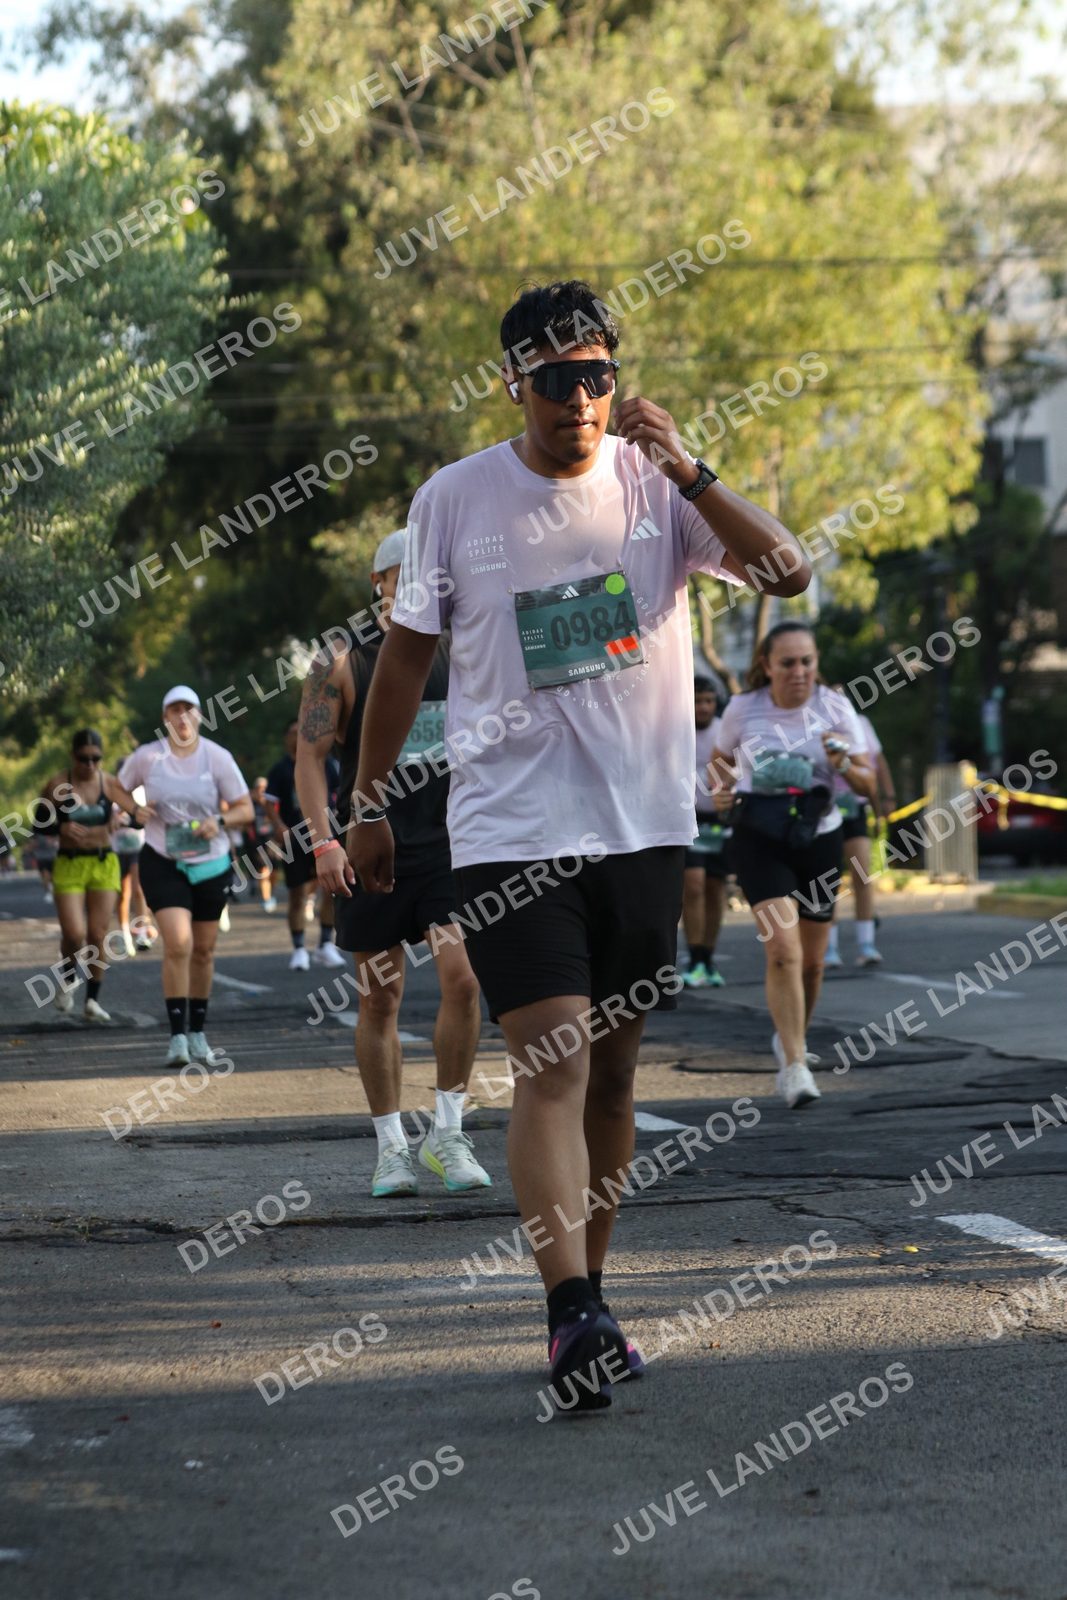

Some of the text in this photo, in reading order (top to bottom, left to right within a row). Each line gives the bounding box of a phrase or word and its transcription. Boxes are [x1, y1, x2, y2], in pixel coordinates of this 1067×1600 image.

[466, 534, 505, 548] ADIDAS
[468, 544, 505, 558] SPLITS
[469, 561, 508, 576] SAMSUNG
[550, 600, 634, 651] 0984
[568, 662, 606, 677] SAMSUNG
